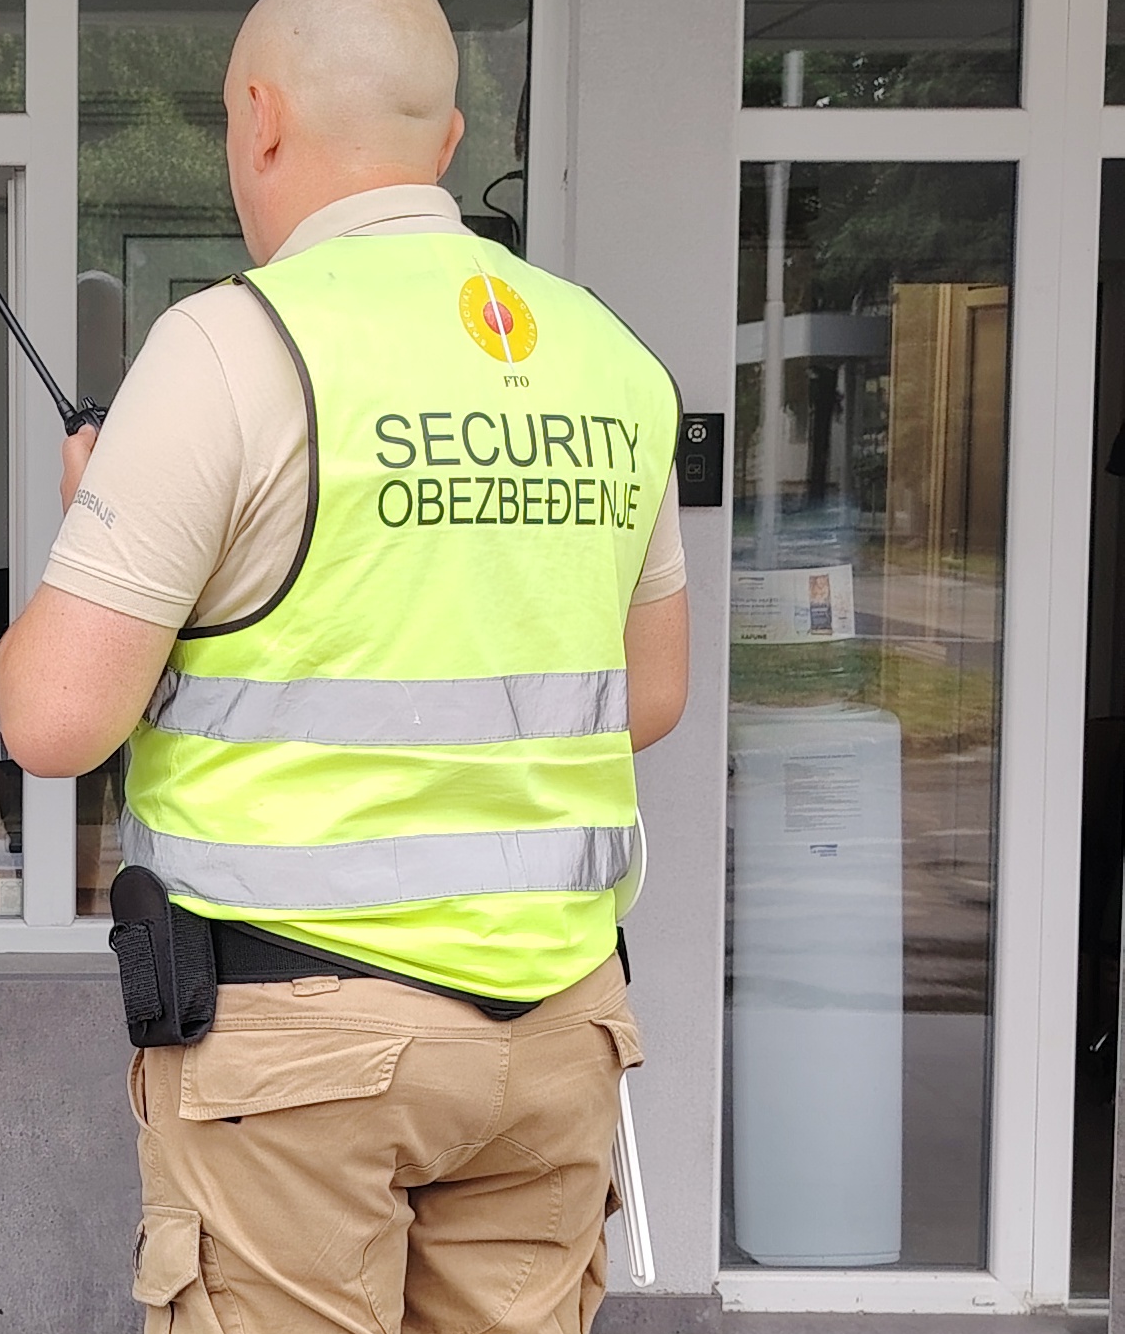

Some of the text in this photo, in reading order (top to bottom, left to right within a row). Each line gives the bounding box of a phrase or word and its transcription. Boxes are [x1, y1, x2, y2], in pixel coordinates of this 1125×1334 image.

[503, 374, 530, 388] FTO
[375, 412, 639, 473] SECURITY
[378, 477, 641, 530] OBEZBEĐENJE
